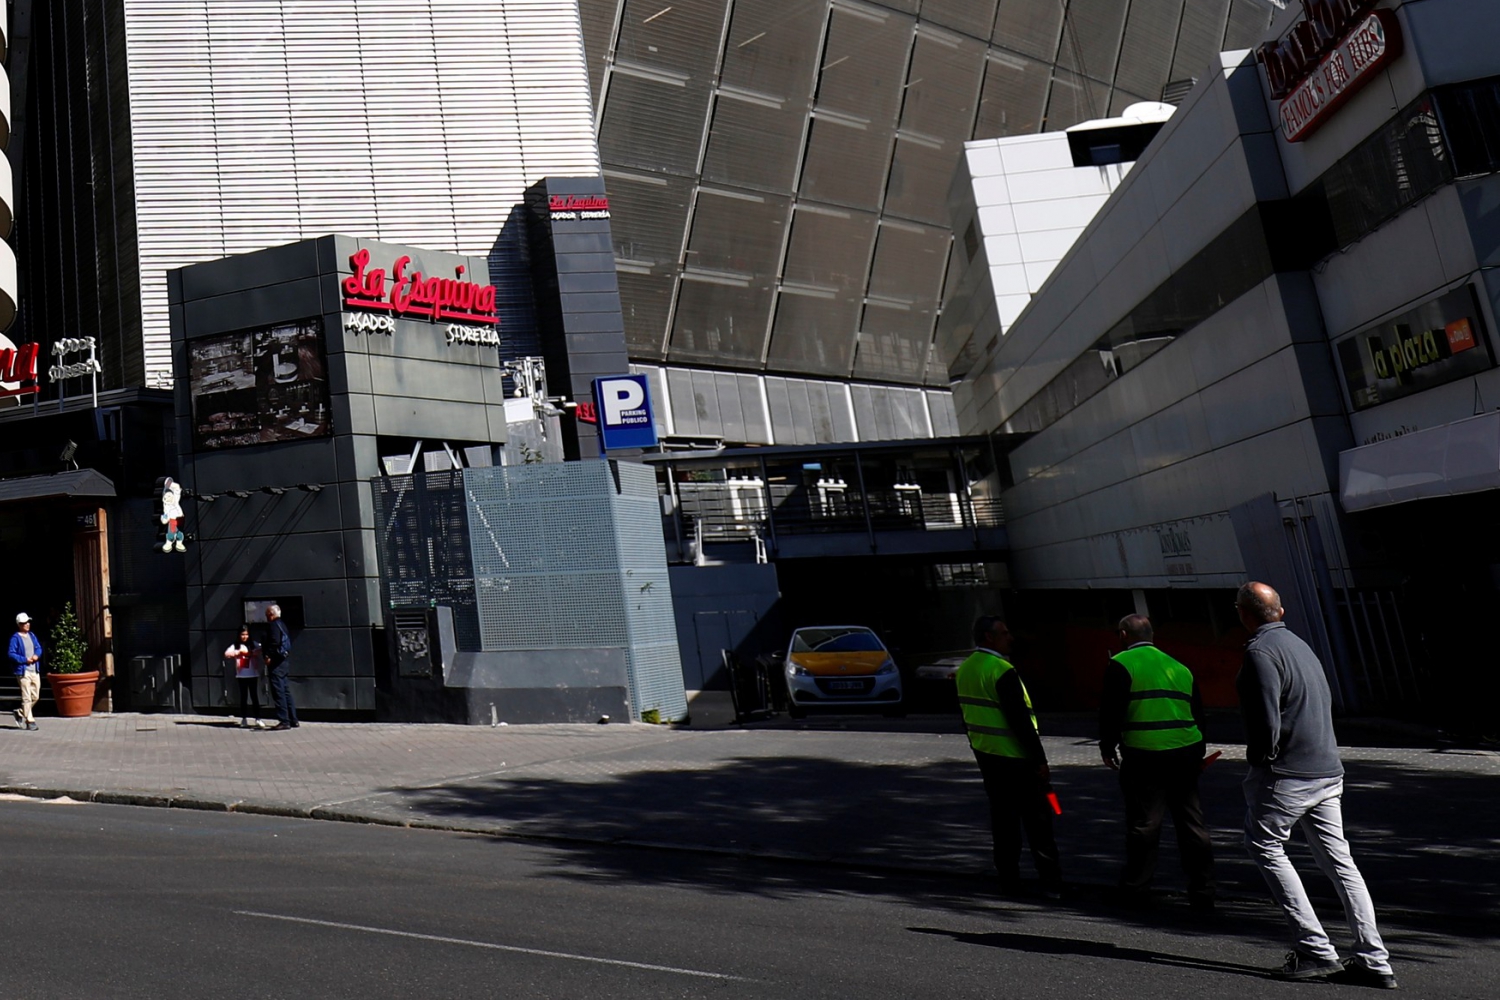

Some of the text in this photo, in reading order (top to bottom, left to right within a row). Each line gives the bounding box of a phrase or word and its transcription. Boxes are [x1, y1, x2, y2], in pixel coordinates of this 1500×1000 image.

[1283, 21, 1382, 134] FAMOUS FOR RIBS
[342, 248, 498, 320] La Esquina
[347, 312, 501, 346] ASADOR SIDRERÍA
[1366, 324, 1440, 387] la plaza
[601, 379, 644, 425] P
[621, 409, 647, 418] PARKING
[84, 514, 94, 525] 46
